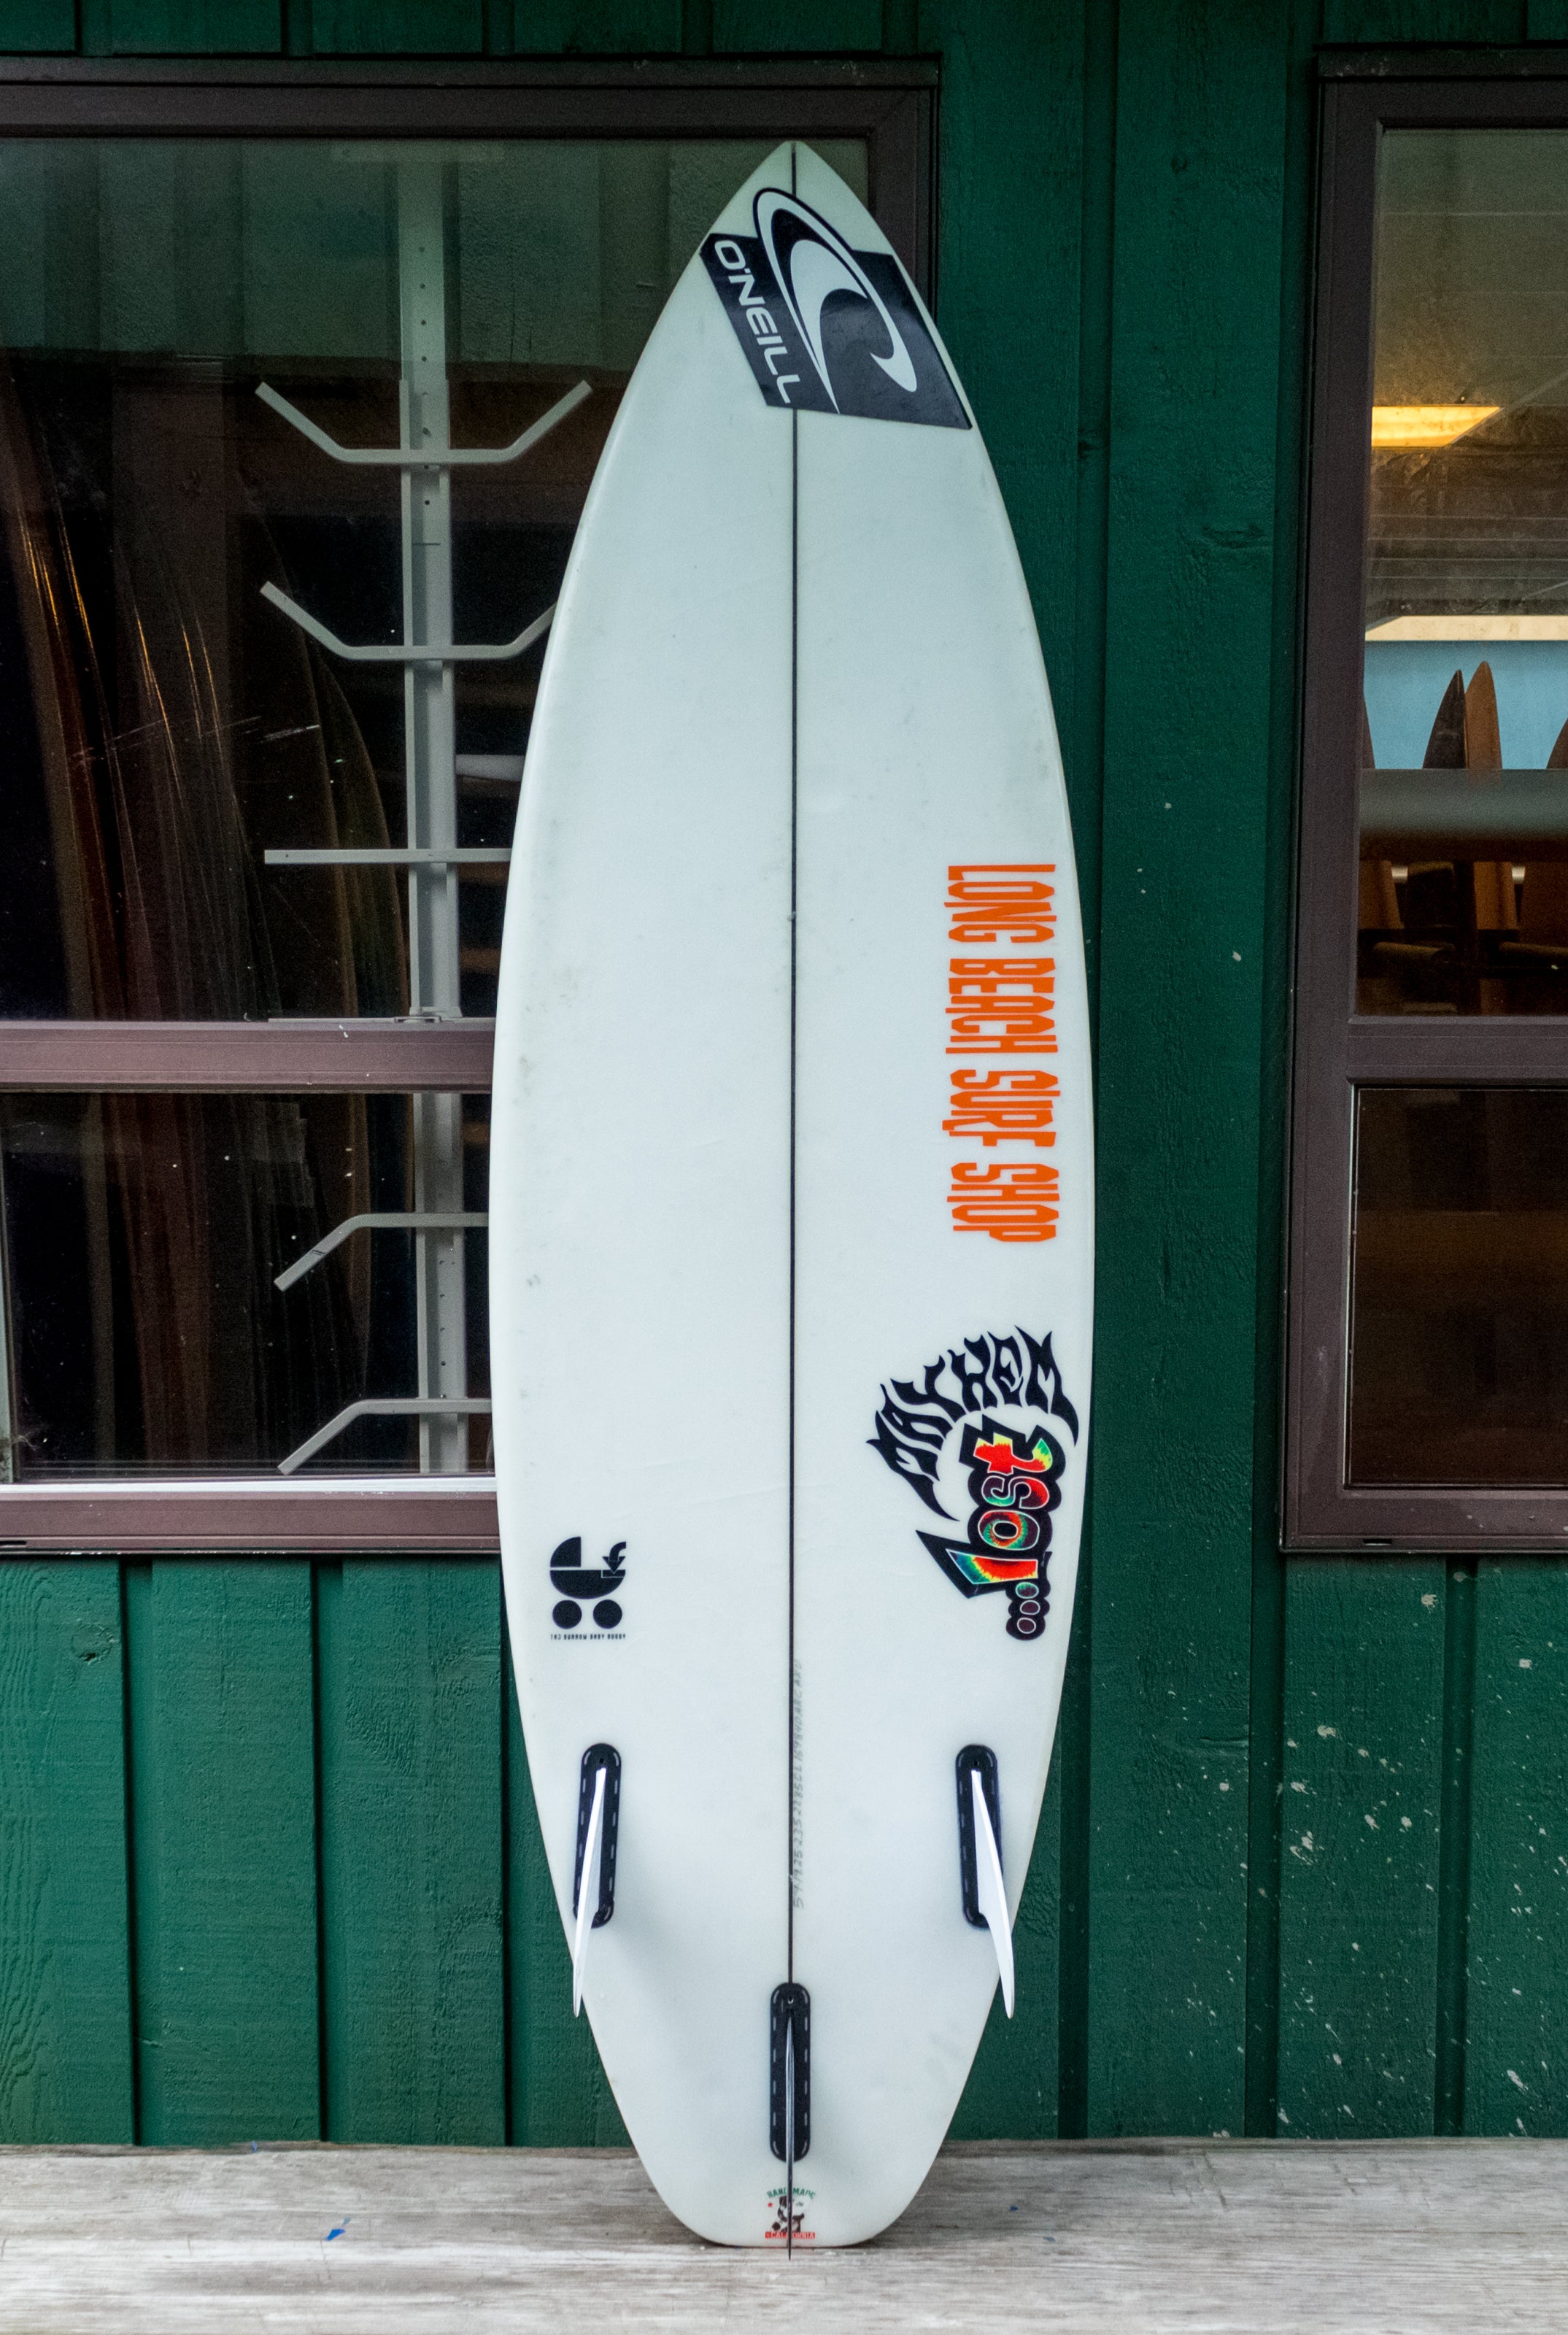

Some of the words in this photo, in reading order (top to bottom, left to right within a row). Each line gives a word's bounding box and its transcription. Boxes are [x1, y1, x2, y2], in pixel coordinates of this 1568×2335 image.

[714, 239, 800, 404] O'NEILL
[943, 864, 1057, 943] LONG
[945, 957, 1059, 1054] BEACH
[942, 1069, 1061, 1147] SURF
[946, 1162, 1060, 1243] SHOP
